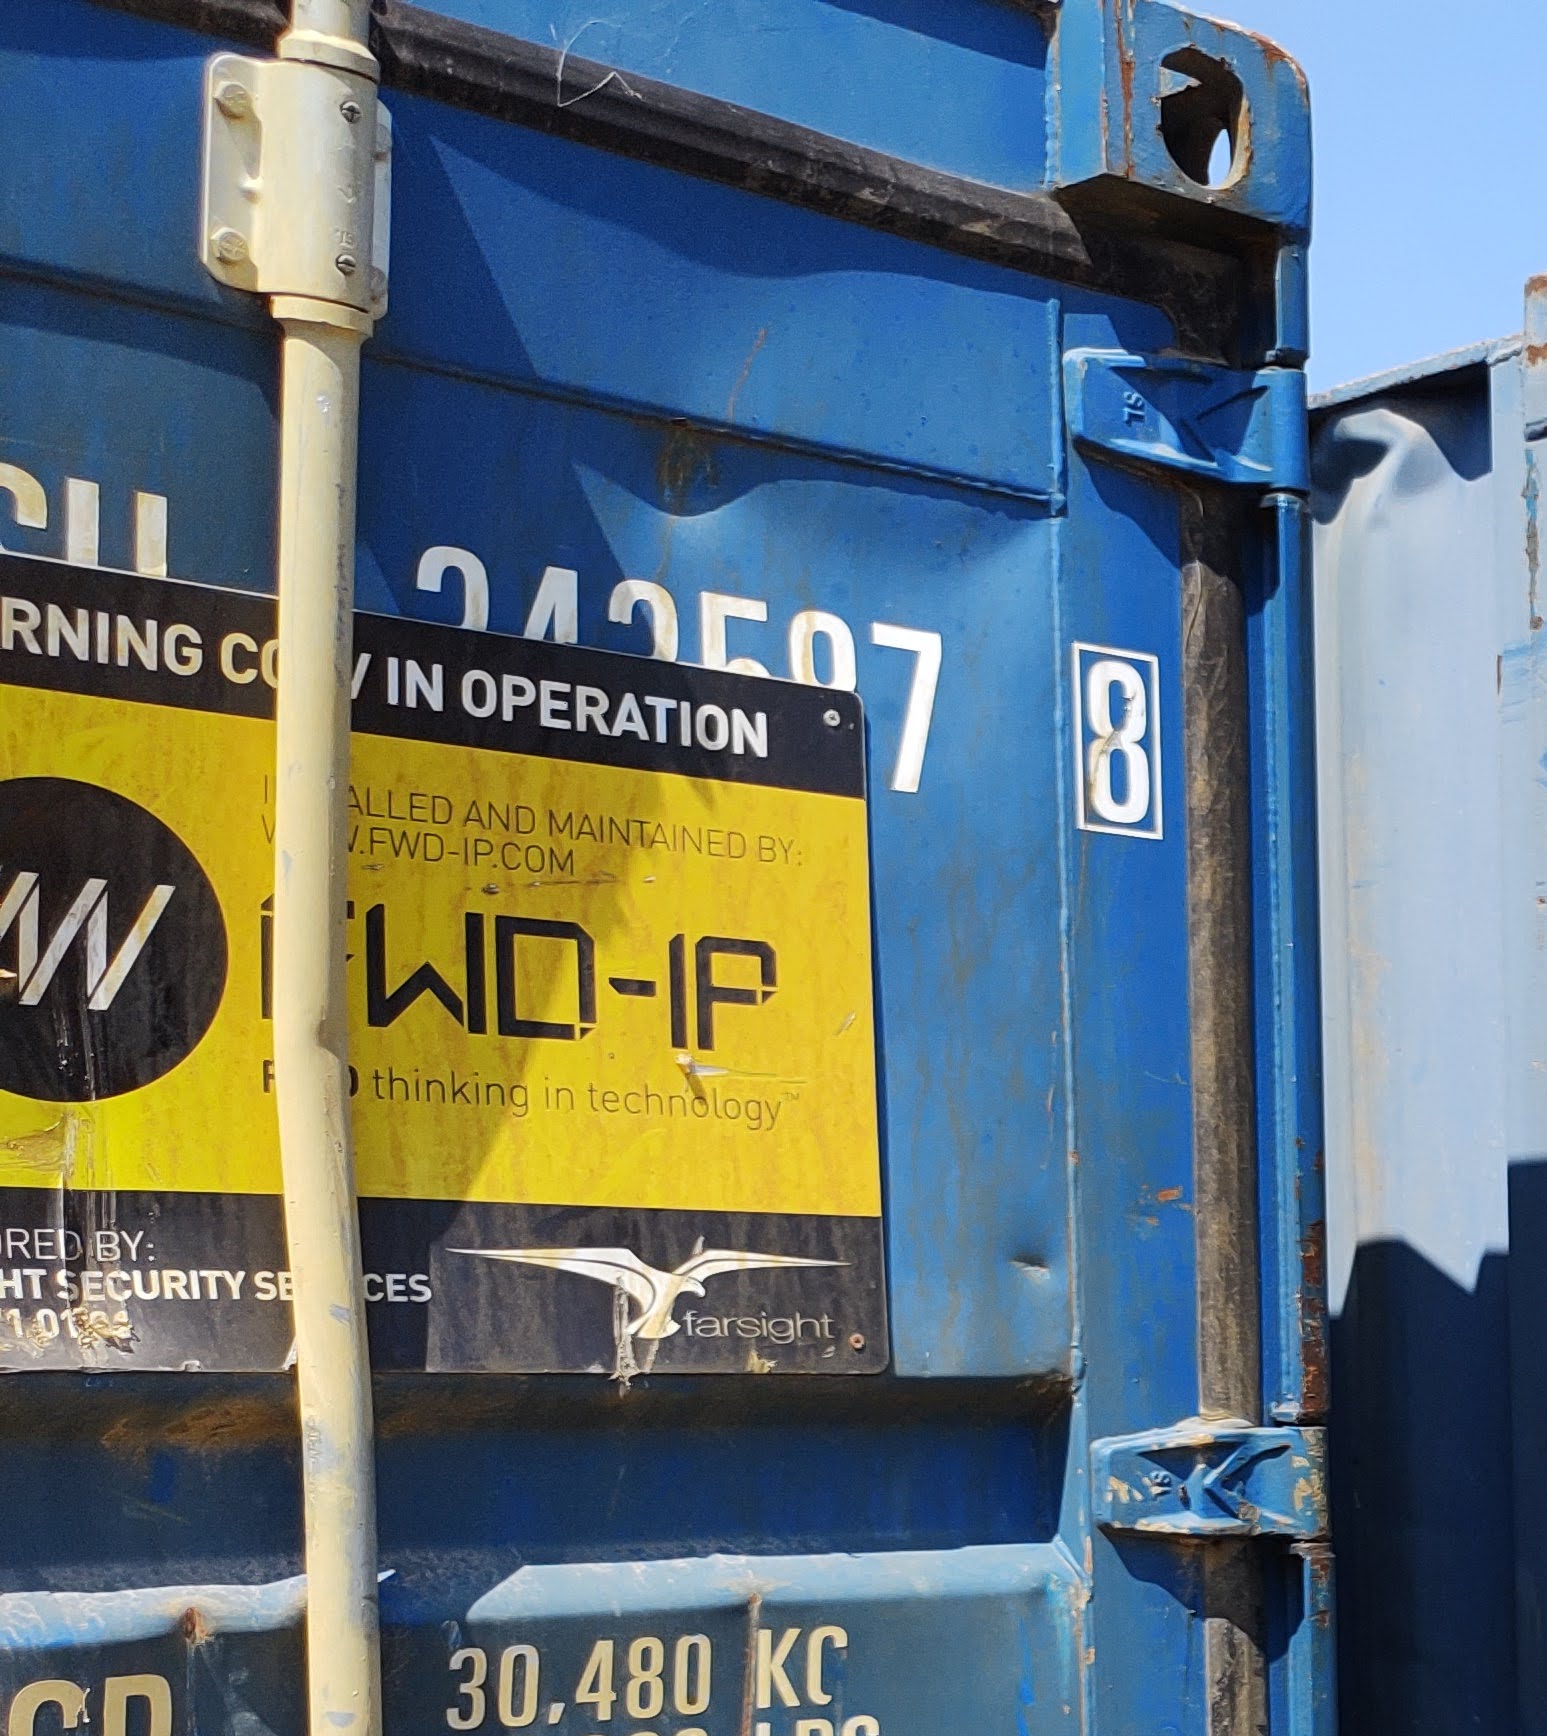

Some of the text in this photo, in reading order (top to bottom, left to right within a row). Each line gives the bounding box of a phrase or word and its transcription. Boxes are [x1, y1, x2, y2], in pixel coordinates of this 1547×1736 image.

[0, 595, 203, 677] RNING
[387, 656, 444, 712] IN
[460, 668, 769, 759] OPERATION
[1086, 660, 1150, 824] 8
[264, 774, 803, 867] IALLED AND MAINTAINED BY:
[372, 1065, 528, 1118] thinking
[544, 1075, 575, 1111] in
[0, 1228, 156, 1262] RED BY:
[56, 1268, 247, 1301] SECURITY
[254, 1270, 432, 1302] SECES
[681, 1310, 836, 1345] farsight
[444, 1632, 714, 1733] 30,480
